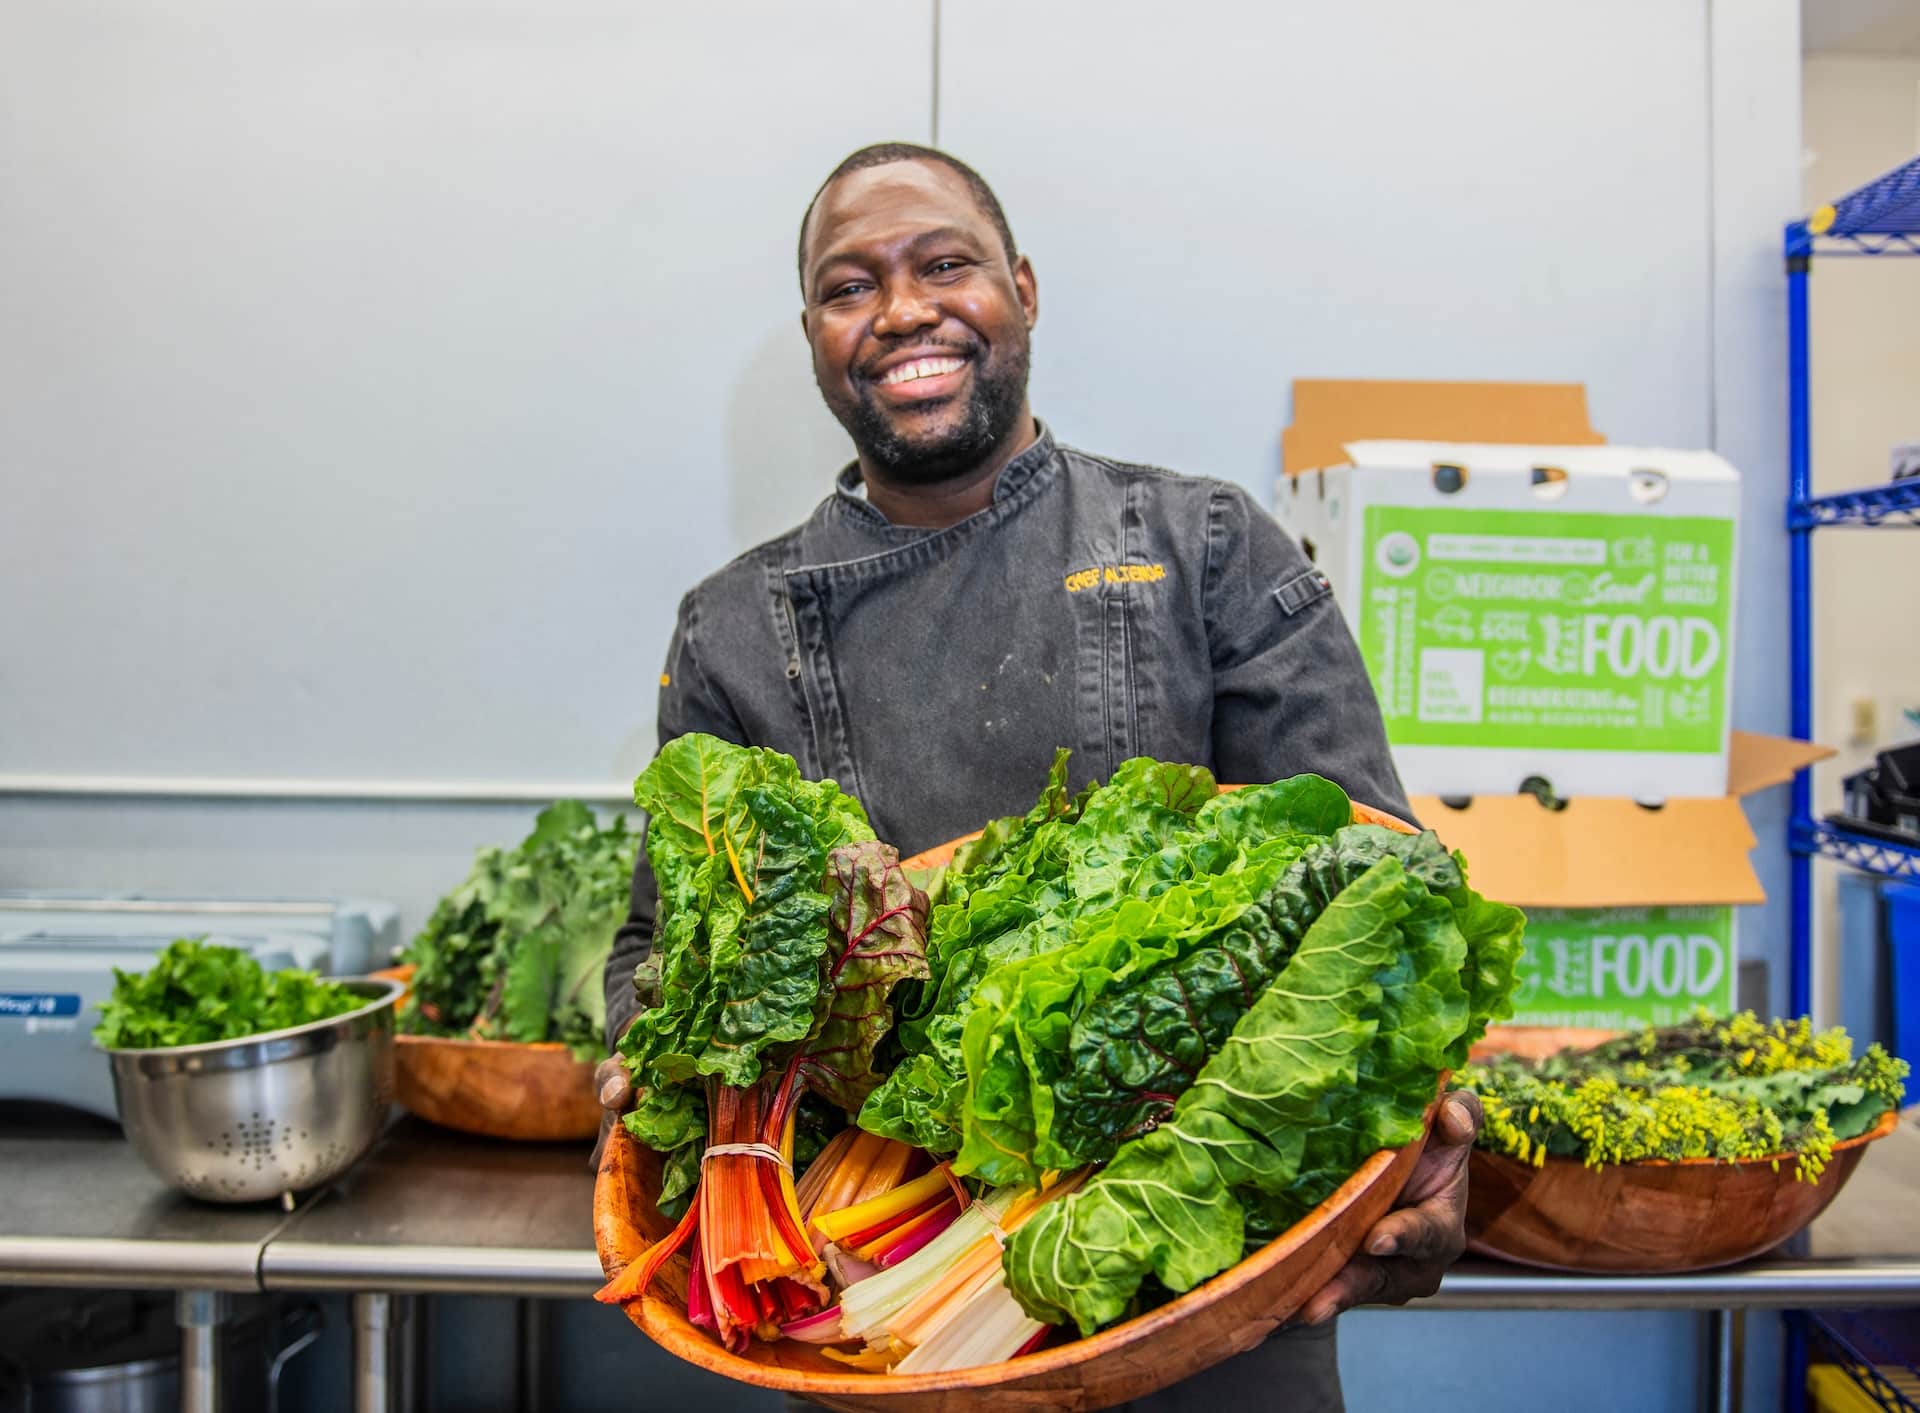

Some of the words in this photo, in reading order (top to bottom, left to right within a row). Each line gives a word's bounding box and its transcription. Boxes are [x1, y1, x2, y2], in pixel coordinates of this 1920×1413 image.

[1065, 567, 1100, 592] CHEF
[1583, 613, 1720, 679] FOOD
[1592, 933, 1722, 997] FOOD
